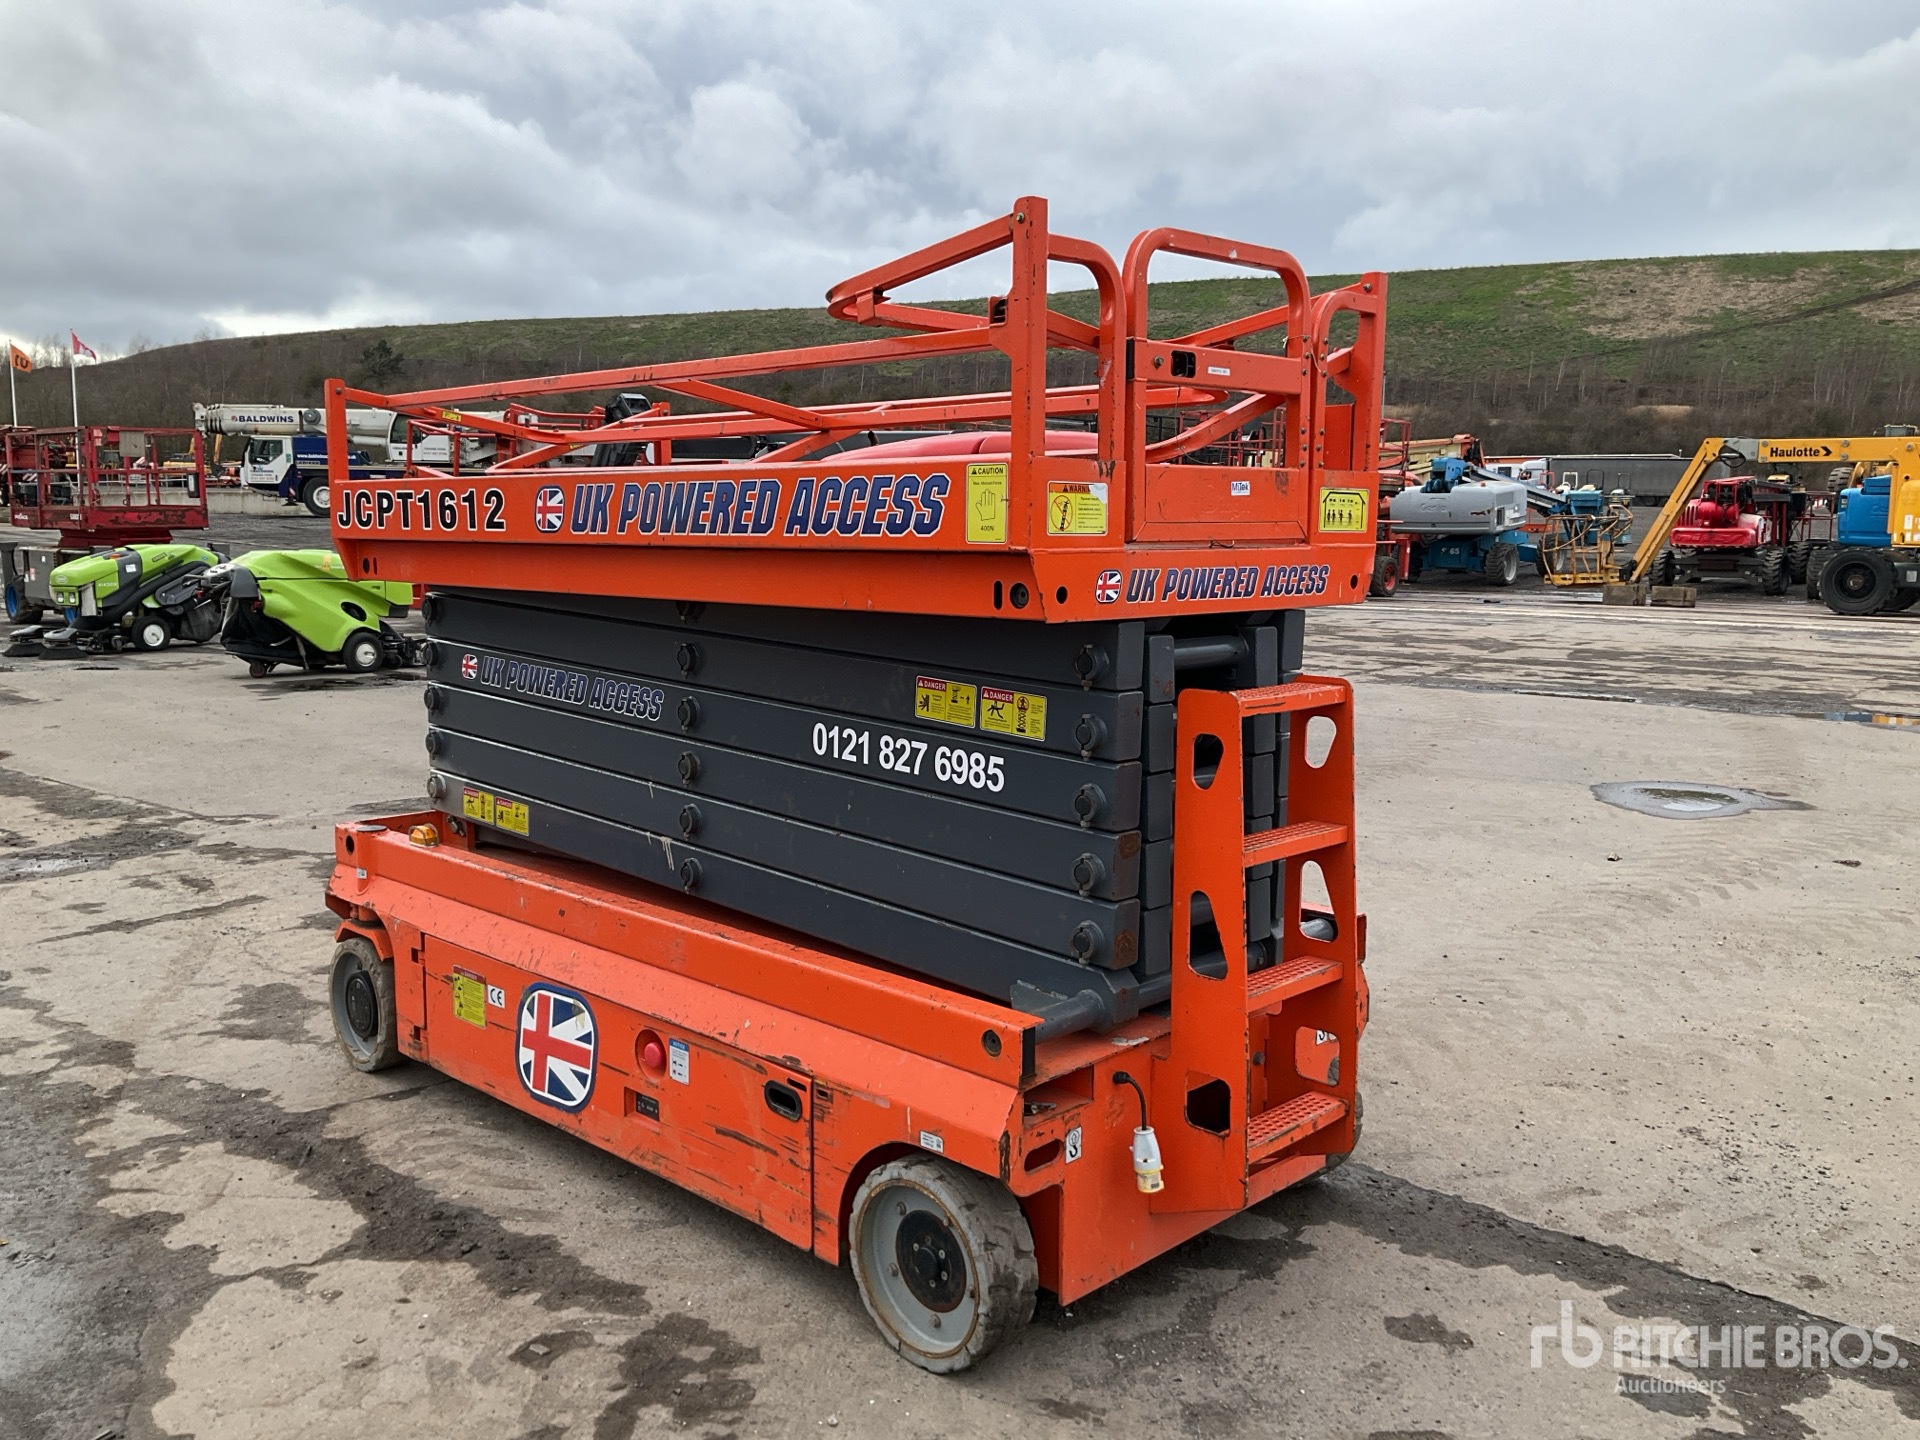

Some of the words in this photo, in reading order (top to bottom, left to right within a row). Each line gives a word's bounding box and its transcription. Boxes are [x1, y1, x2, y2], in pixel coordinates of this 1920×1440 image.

[238, 415, 294, 423] BALDWINS
[1770, 447, 1820, 457] Haulotte
[977, 467, 1004, 475] CAUTION
[336, 487, 506, 532] JCPT1612
[570, 483, 615, 535] UK
[617, 479, 782, 536] POWERED
[783, 473, 951, 537] ACCESS
[1450, 547, 1460, 555] 65
[1125, 568, 1161, 604] UK
[1161, 566, 1260, 602] POWERED
[1260, 564, 1330, 598] ACCESS
[480, 655, 506, 688] UK
[505, 660, 589, 706] POWERED
[588, 677, 665, 722] ACCESS
[924, 680, 946, 691] DANGER
[989, 691, 1013, 702] DANGER
[812, 722, 870, 765] 0121
[878, 734, 928, 776] 827
[934, 745, 1005, 793] 6985
